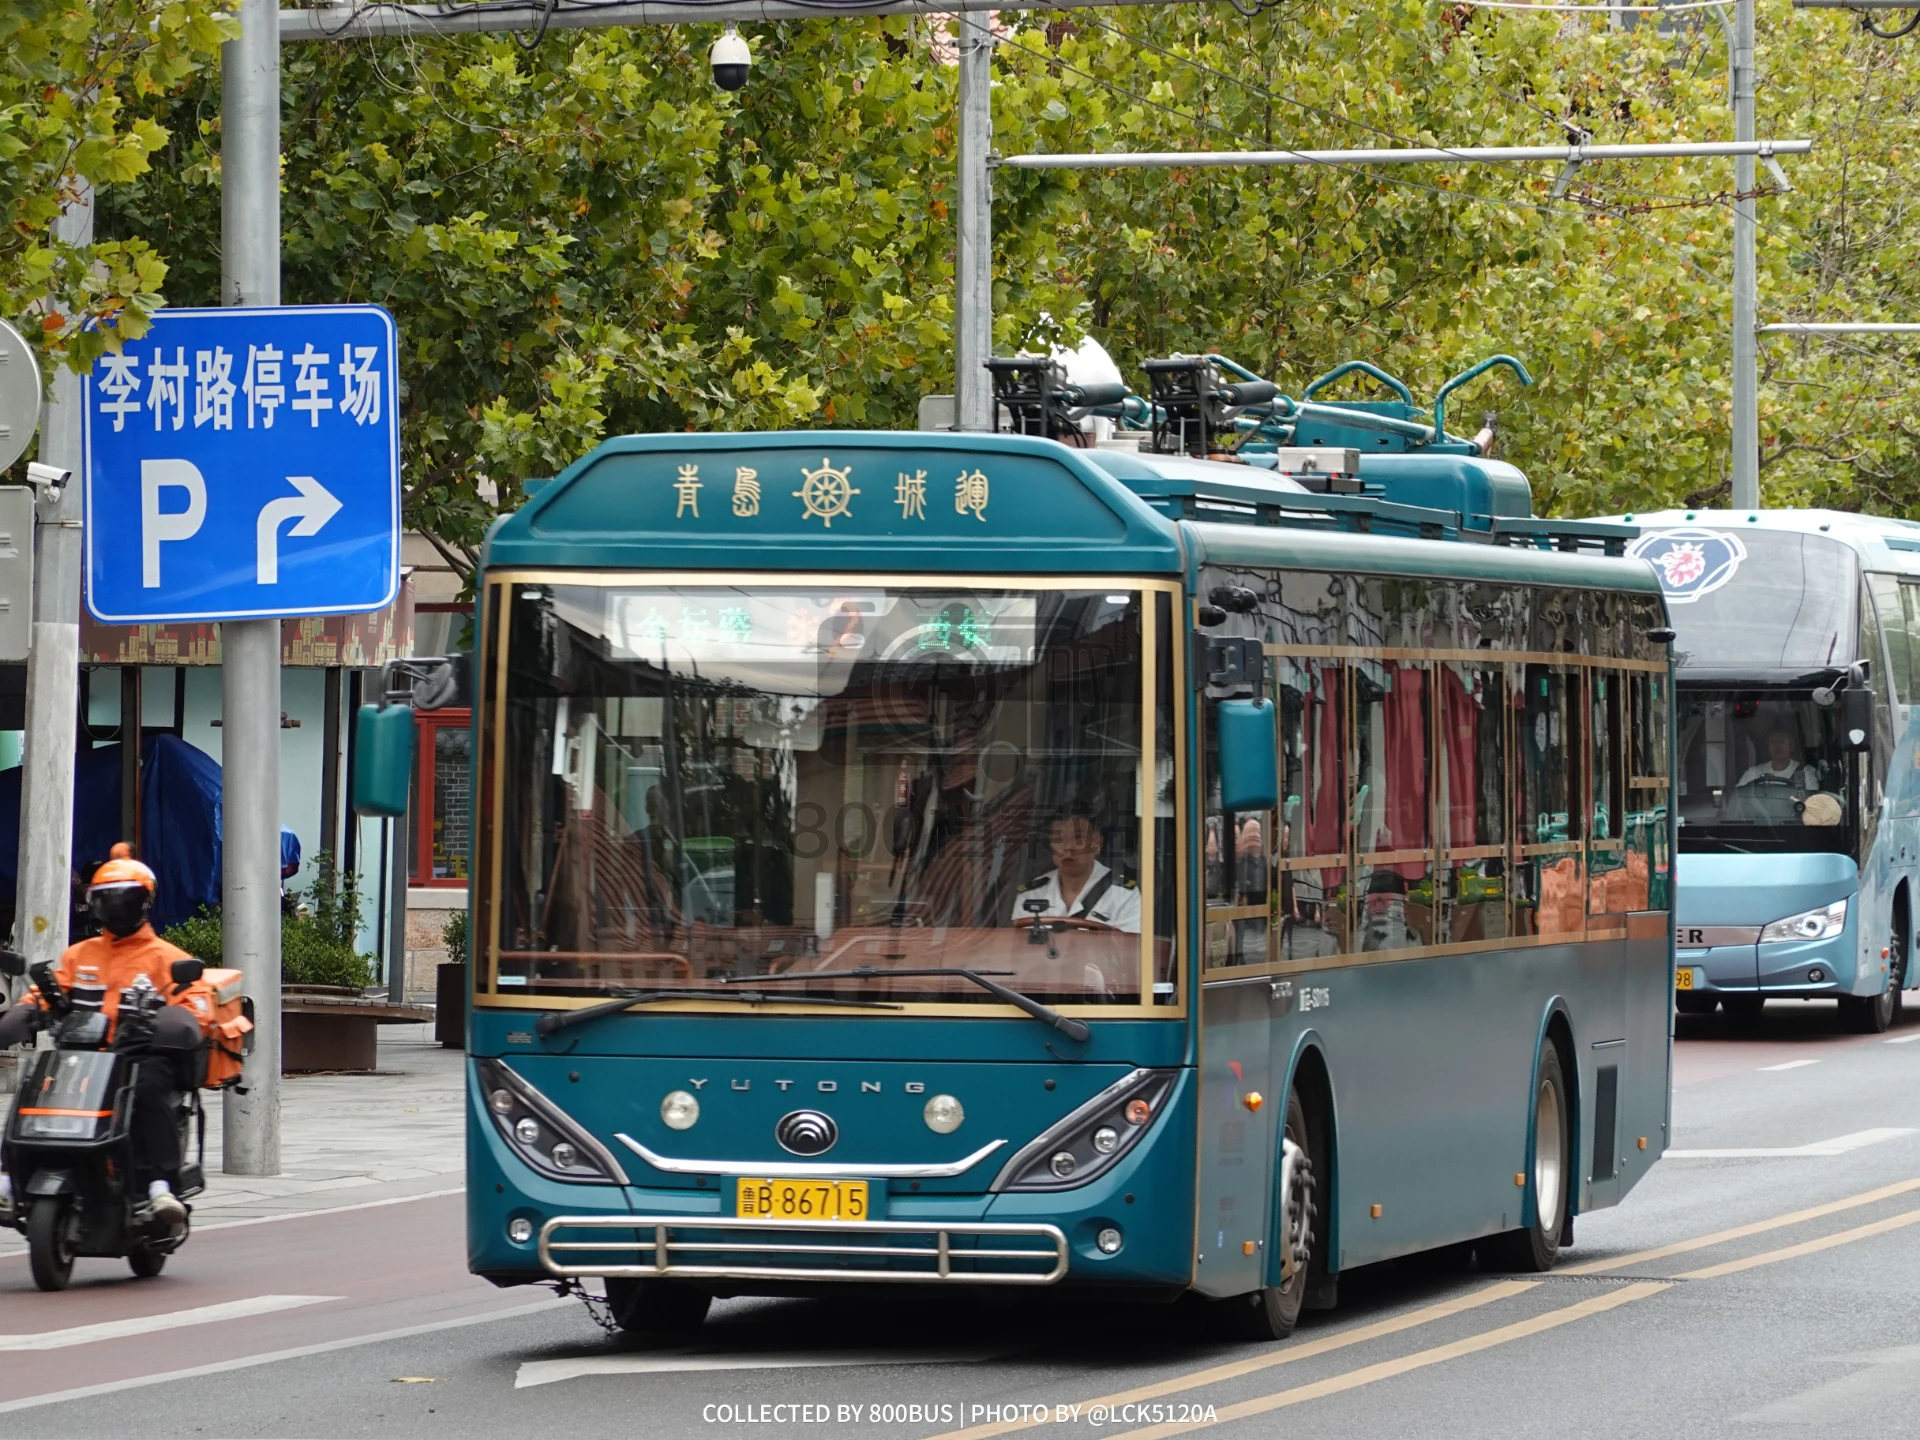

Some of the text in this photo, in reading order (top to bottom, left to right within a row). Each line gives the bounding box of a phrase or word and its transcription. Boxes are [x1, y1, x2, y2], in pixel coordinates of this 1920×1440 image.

[97, 342, 381, 432] 李村路停车场
[140, 459, 207, 588] P
[689, 1078, 926, 1094] YUTONG
